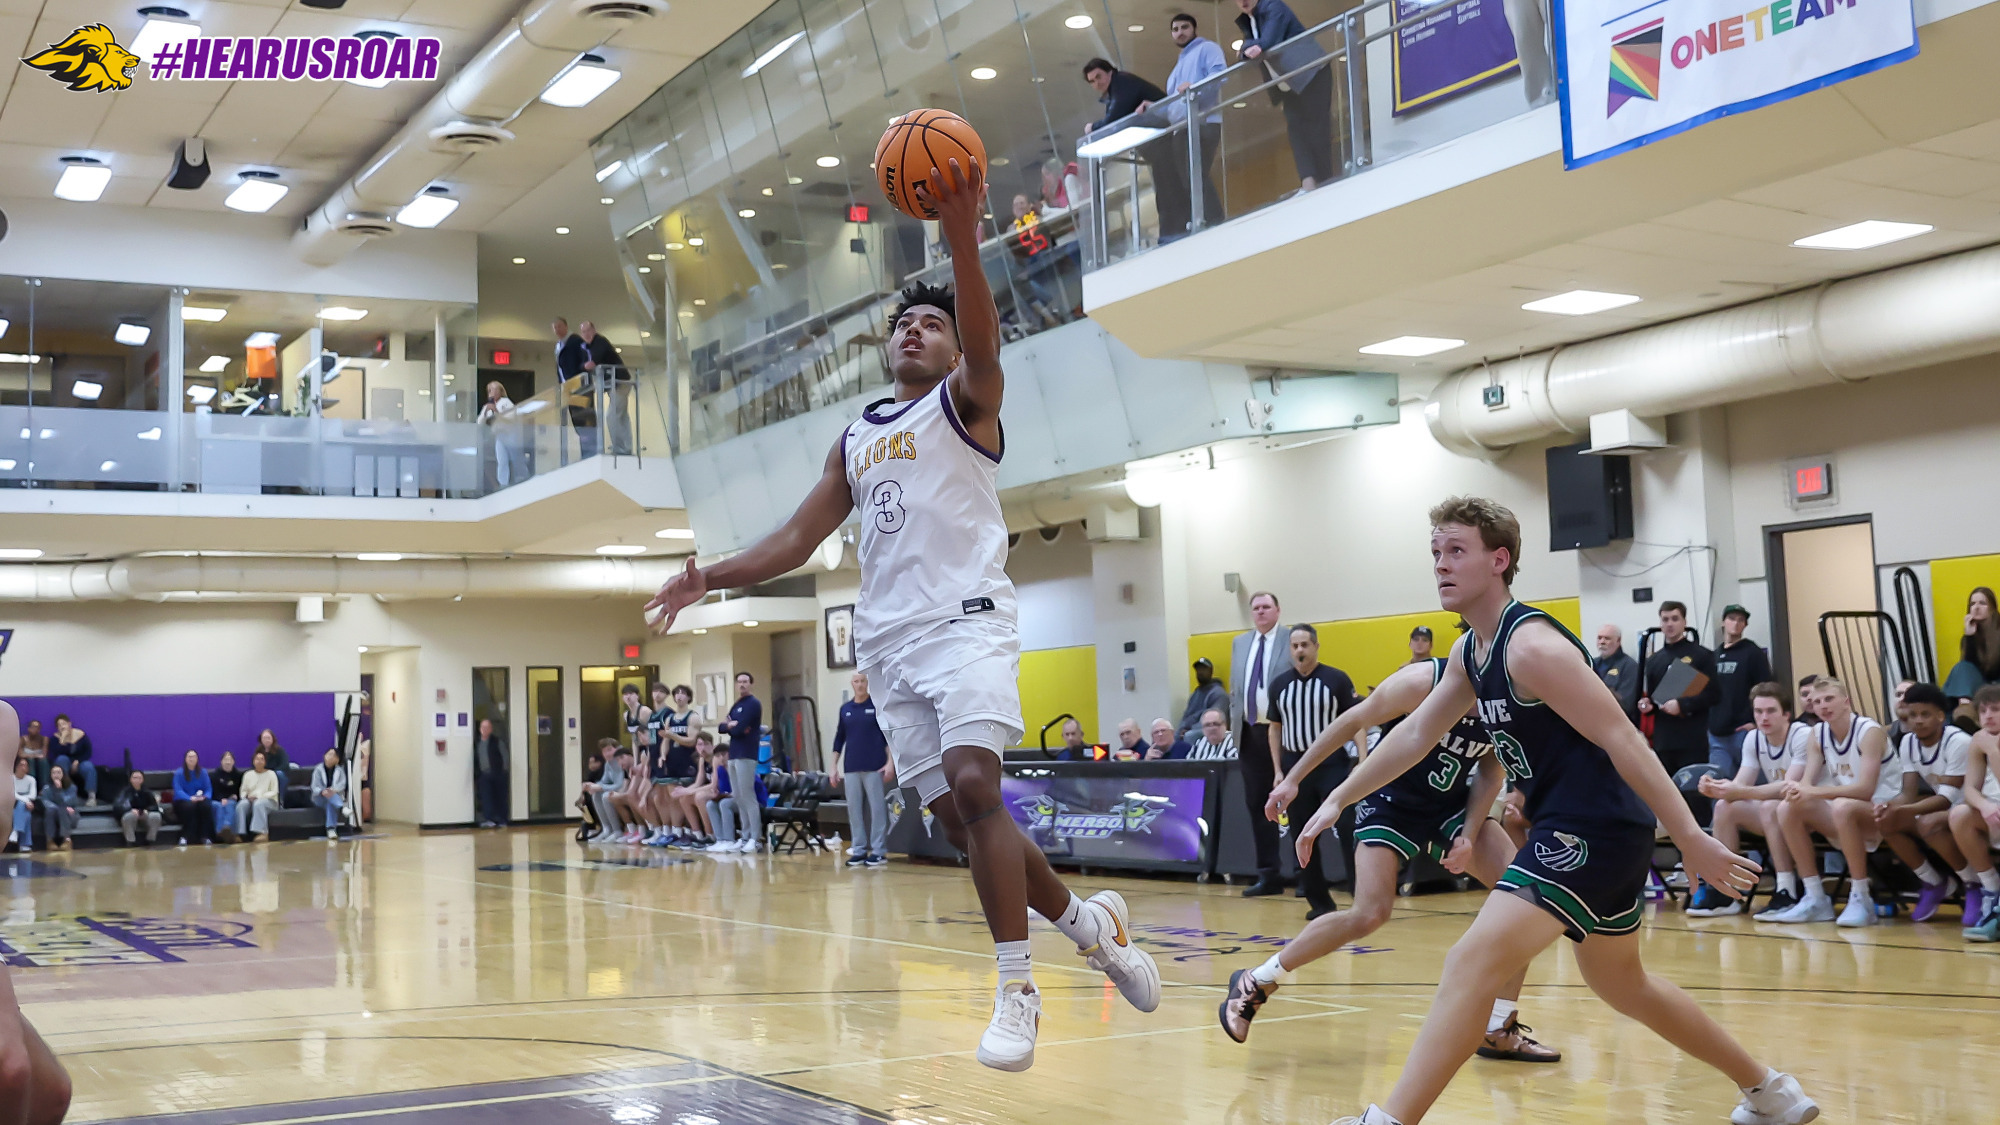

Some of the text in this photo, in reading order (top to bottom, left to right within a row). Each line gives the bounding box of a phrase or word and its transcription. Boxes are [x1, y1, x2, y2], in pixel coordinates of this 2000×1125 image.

[853, 431, 917, 480] LIONS
[872, 479, 906, 535] 3
[1428, 753, 1461, 791] 3
[1038, 815, 1141, 829] EMERSON
